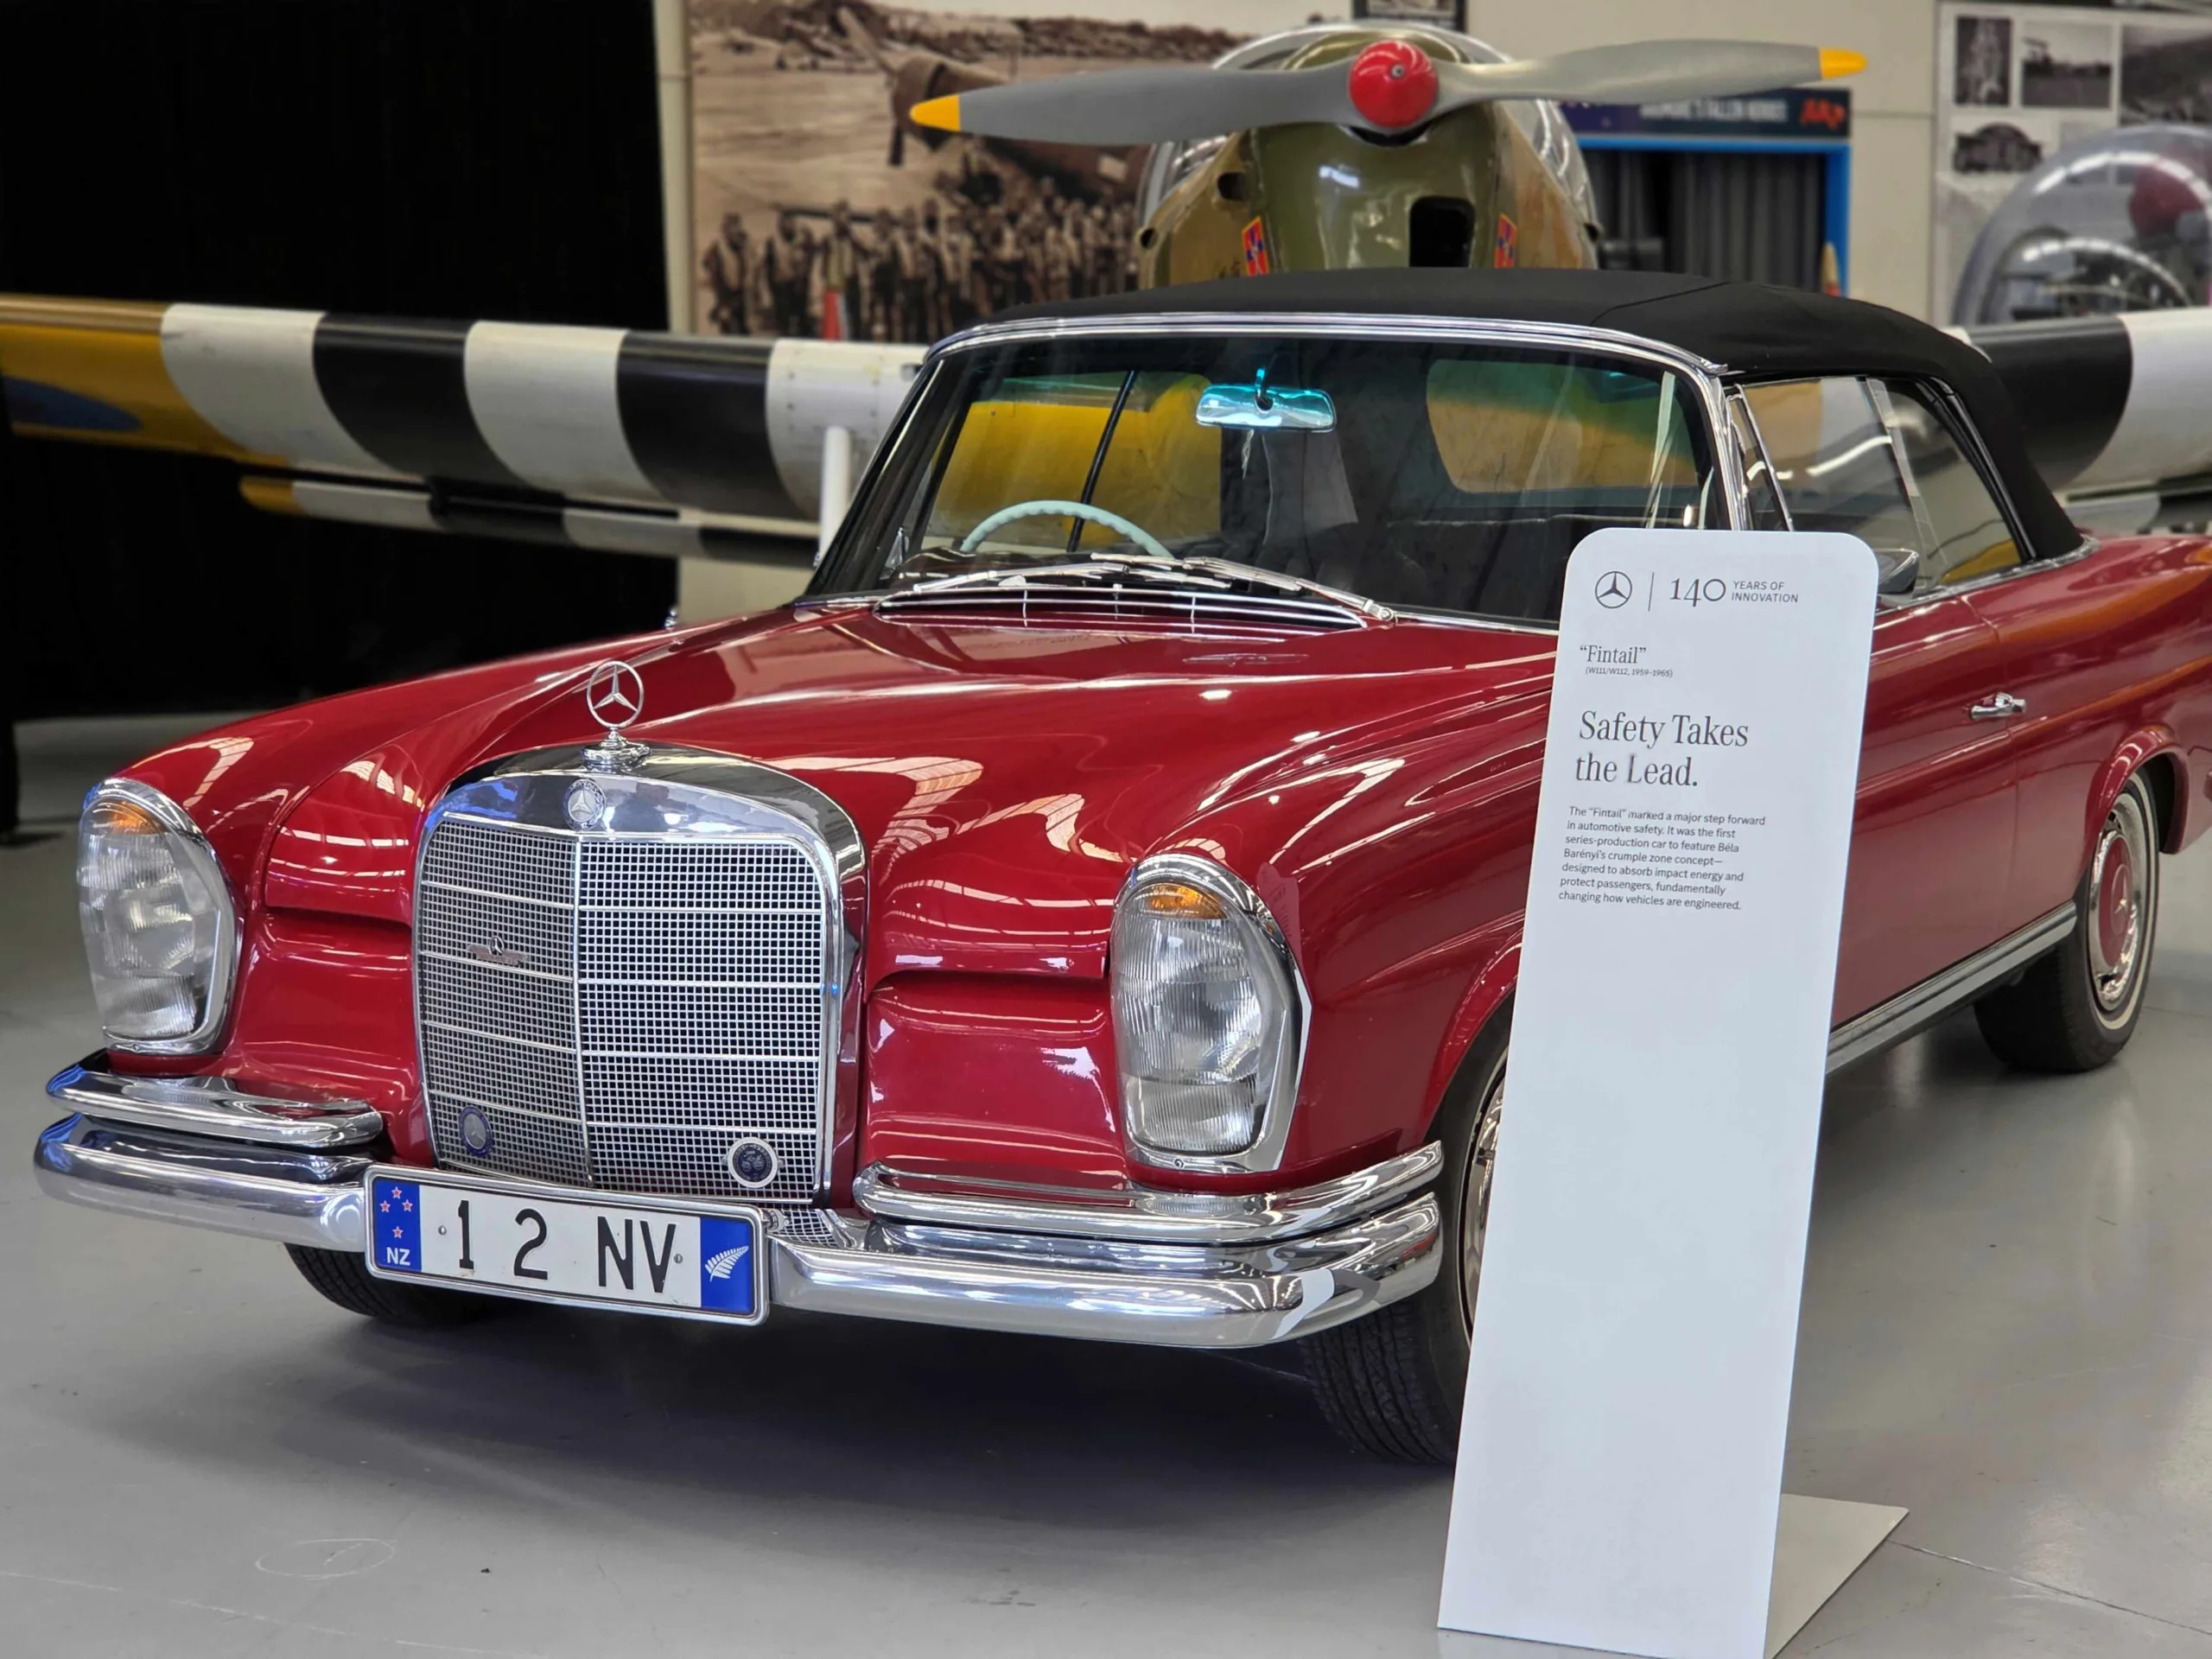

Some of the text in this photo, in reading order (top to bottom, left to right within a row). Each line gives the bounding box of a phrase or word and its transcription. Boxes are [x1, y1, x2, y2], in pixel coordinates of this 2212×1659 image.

[1670, 577, 1785, 607] 140 YEARS OF
[1731, 592, 1799, 603] INNOVATION
[1580, 644, 1647, 664] “Fintail”
[1580, 709, 1749, 749] Safety Takes
[1575, 752, 1699, 787] the Lead.
[1568, 805, 1586, 817] The
[1628, 811, 1664, 821] marked
[1674, 813, 1701, 823] major
[1704, 815, 1725, 825] step
[1727, 814, 1766, 826] forward
[1567, 819, 1736, 839] in automotive safety. It was the first
[1565, 836, 1740, 853] series-production car to feature Béla
[1607, 852, 1647, 863] crumple
[1649, 855, 1673, 864] zone
[1561, 862, 1744, 882] designed to absorb impact energy and
[1560, 878, 1726, 897] protect passengers, fundamentally
[1558, 891, 1741, 911] changing how vehicles are engineered.
[386, 1247, 410, 1266] NZ
[597, 1215, 677, 1294] NV
